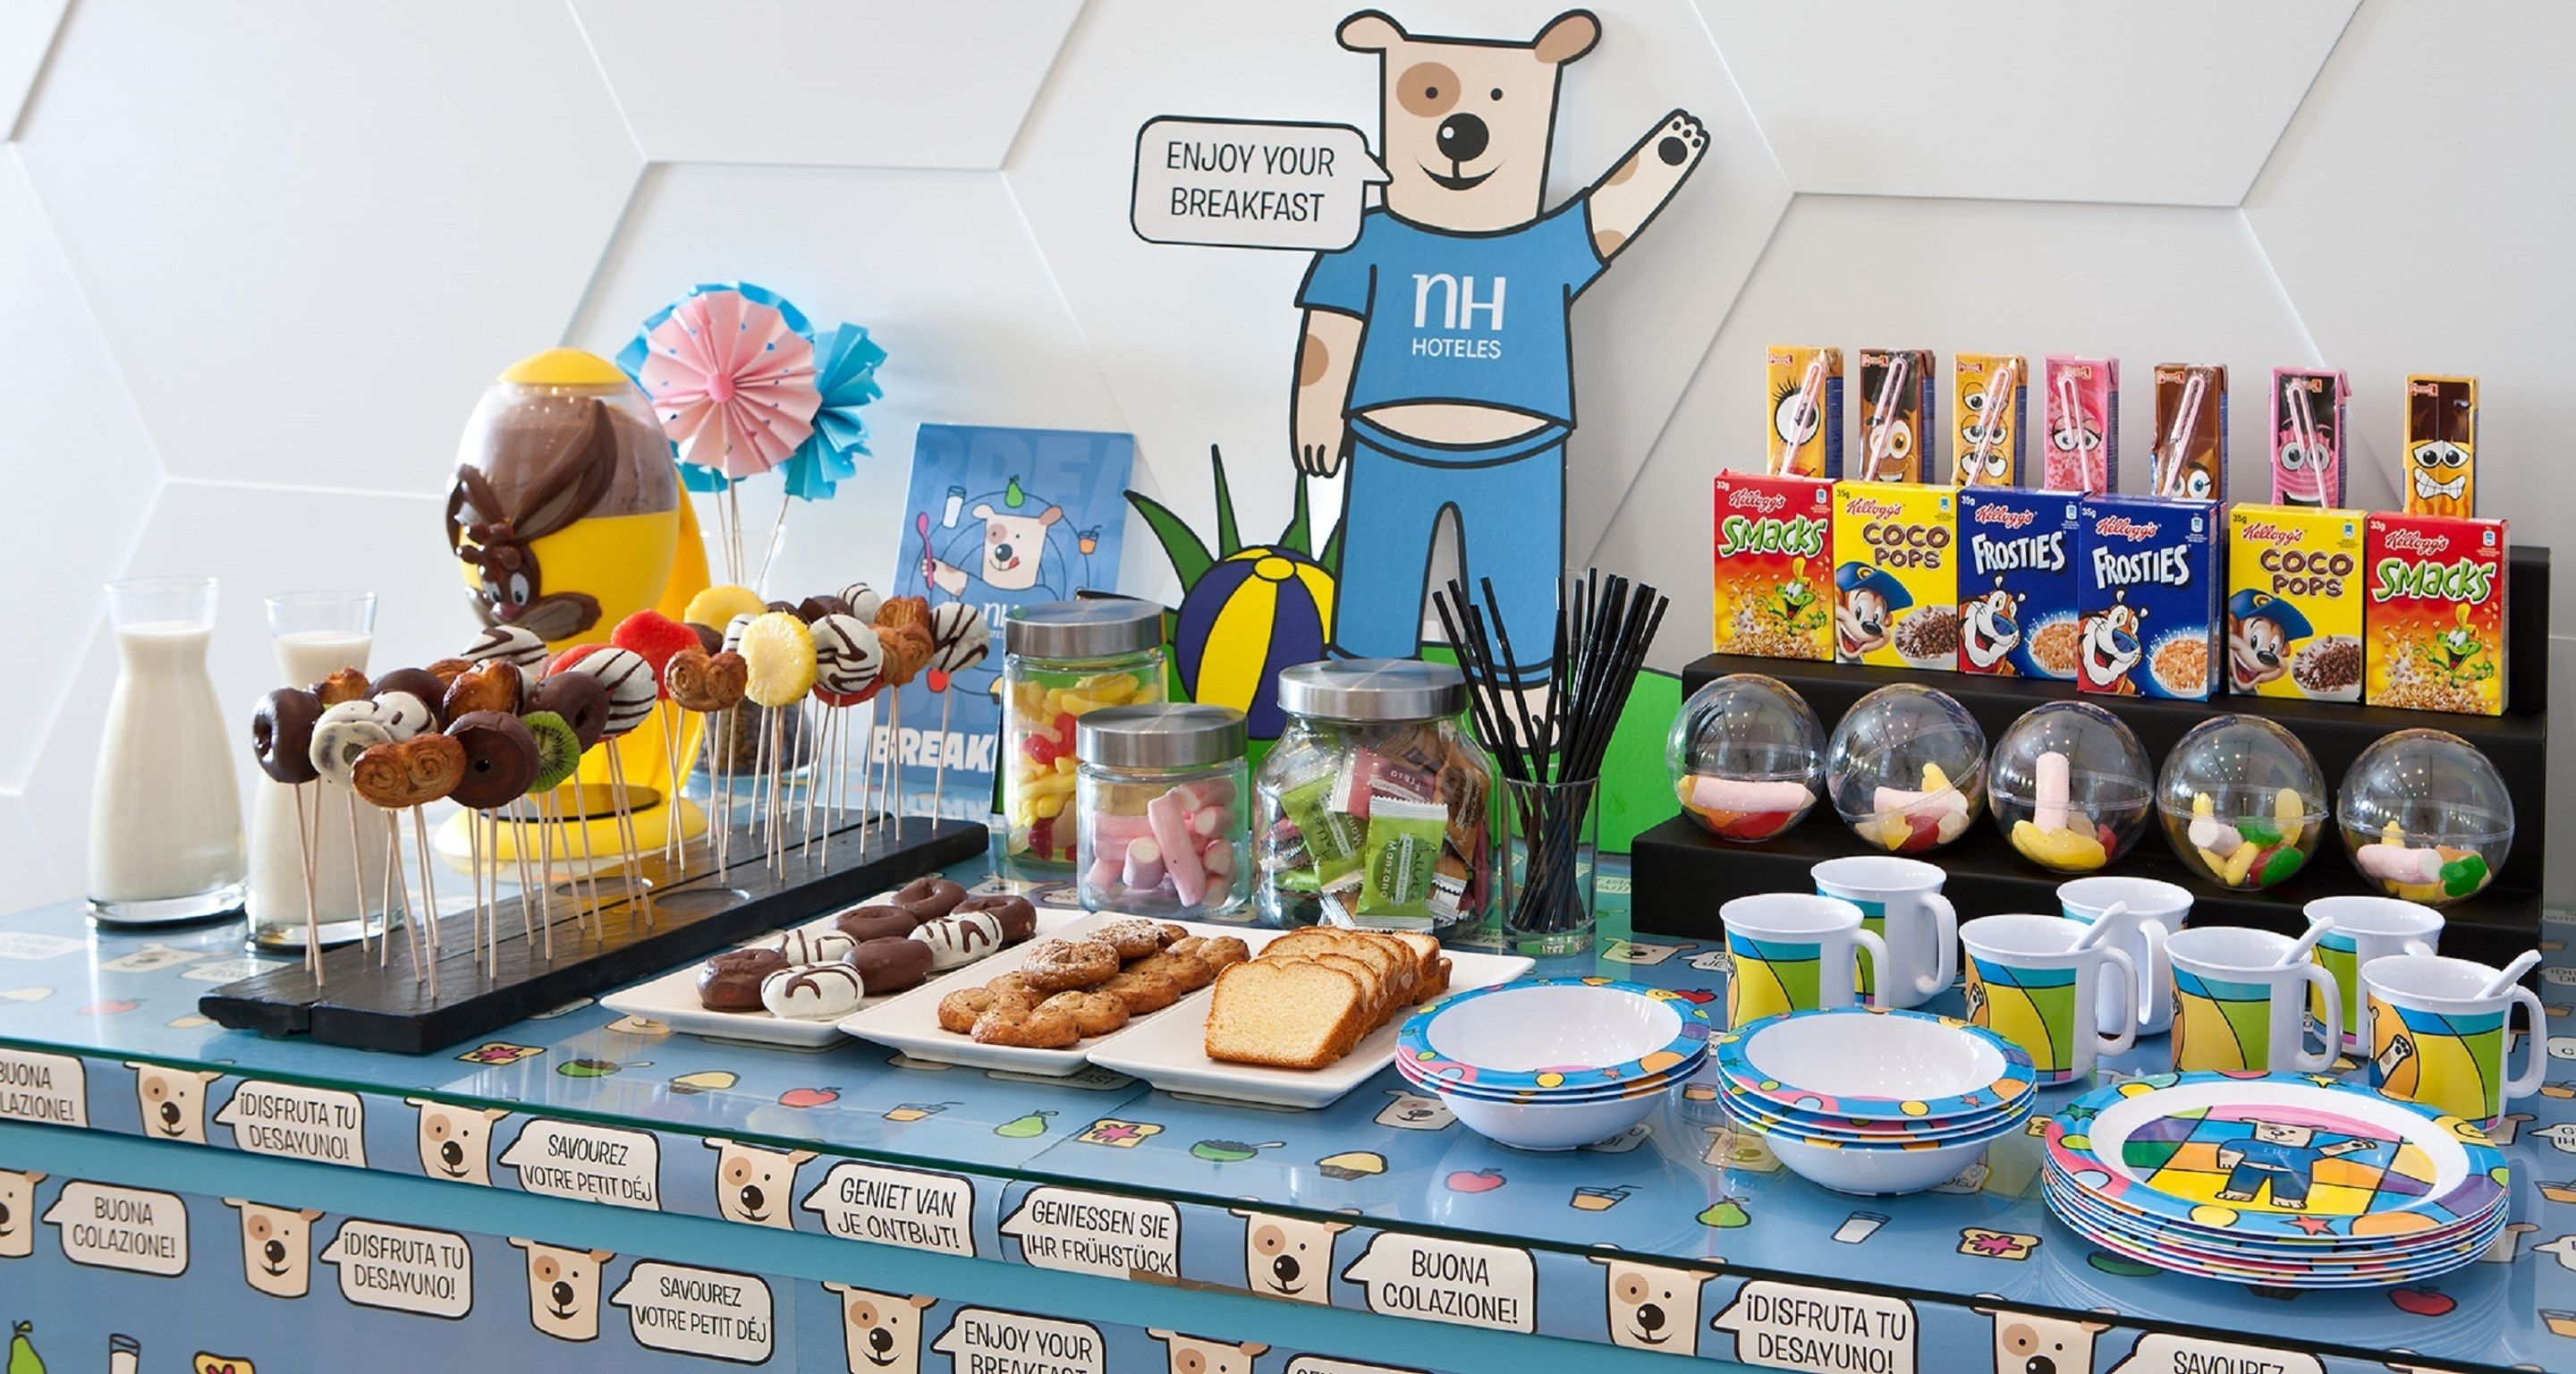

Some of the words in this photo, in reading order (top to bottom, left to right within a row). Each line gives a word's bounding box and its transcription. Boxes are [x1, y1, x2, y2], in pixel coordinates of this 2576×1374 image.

[1167, 141, 1255, 173] ENJOY
[1264, 146, 1335, 177] YOUR
[1171, 187, 1326, 223] BREAKFAST
[1412, 338, 1502, 359] HOTELES
[1729, 488, 1786, 513] Kellogg's
[1846, 497, 1902, 519] Kellogg's
[1962, 496, 1975, 506] 35g
[1975, 503, 2034, 529] Kellogg's
[2081, 507, 2097, 519] 35g
[2233, 513, 2247, 524] 35g
[1862, 522, 1951, 548] COCO
[2096, 515, 2158, 542] Kellogg's
[2242, 522, 2303, 546] Kellogg's
[2385, 529, 2449, 556] Kellogg's
[1874, 547, 1940, 569] POPS
[1971, 530, 2065, 575] FROSTIES
[2092, 544, 2190, 589] FROSTIES
[2259, 547, 2354, 577] COCO
[2272, 573, 2343, 598] POPS
[1380, 838, 1397, 898] Manzana
[240, 1093, 330, 1127] ¡DISFRUTA
[335, 1106, 356, 1130] TU
[250, 1125, 350, 1160] DESAYUNO!
[548, 1133, 629, 1166] SAVOUREZ
[524, 1165, 573, 1191] VOTRE
[578, 1172, 618, 1197] PETIT
[623, 1175, 653, 1202] DÉJ
[840, 1176, 912, 1210] GENIET
[917, 1189, 957, 1219] VAN
[94, 1196, 154, 1226] BUONA
[1032, 1200, 1134, 1235] GENIESSEN
[1140, 1215, 1170, 1240] SIE
[72, 1223, 176, 1260] COLAZIONE!
[838, 1212, 864, 1235] JE
[868, 1216, 961, 1250] ONTBIJT!
[344, 1231, 436, 1268] ¡DISFRUTA
[440, 1245, 464, 1270] TU
[1028, 1234, 1058, 1259] IHR
[1063, 1238, 1174, 1275] FRÜHSTÜCK
[1411, 1249, 1490, 1287] BUONA
[354, 1263, 455, 1301] DESAYUNO!
[660, 1276, 741, 1308] SAVOUREZ
[1382, 1282, 1518, 1325] COLAZIONE!
[1747, 1293, 1869, 1337] ¡DISFRUTA
[1876, 1310, 1906, 1342] TU
[634, 1305, 686, 1332] VOTRE
[691, 1312, 733, 1338] PETIT
[736, 1316, 767, 1344] DÉJ
[965, 1320, 1030, 1353] ENJOY
[1036, 1330, 1093, 1363] YOUR
[1758, 1333, 1894, 1374] DESAYUNO!
